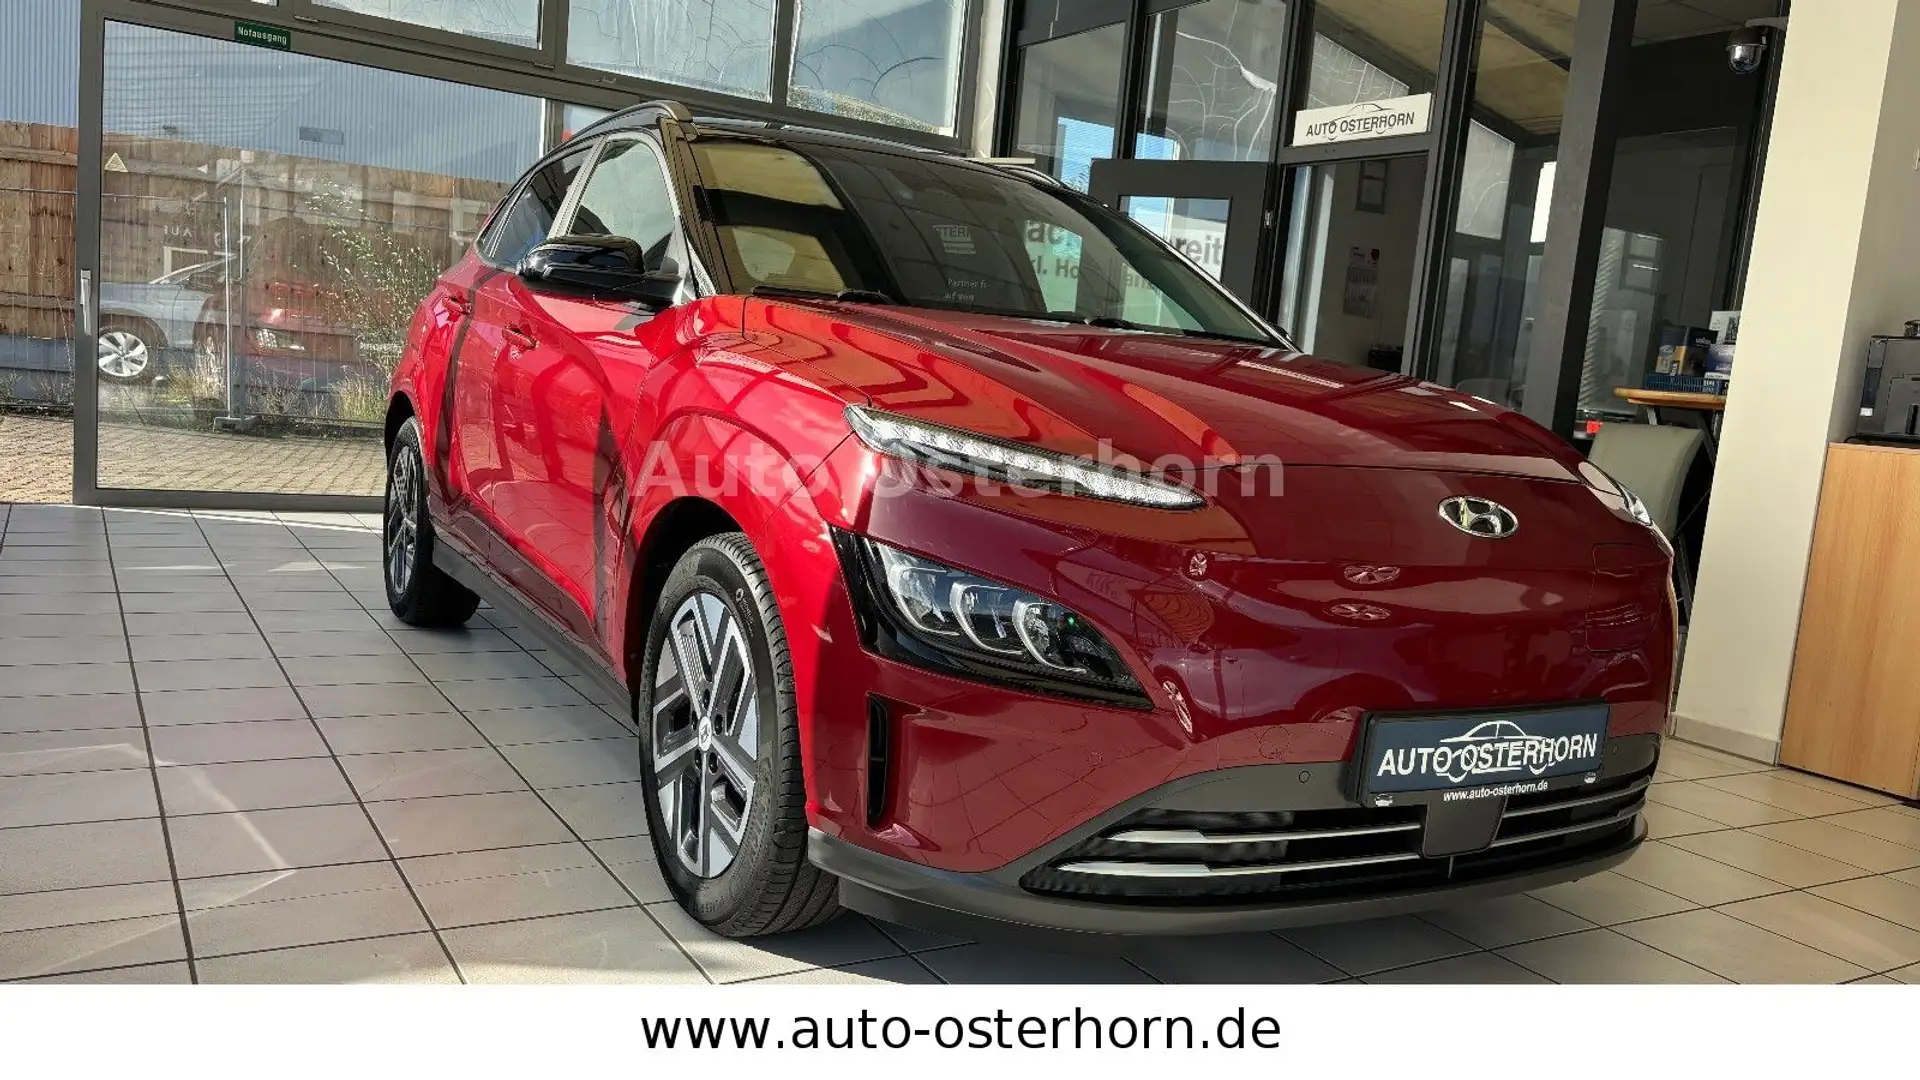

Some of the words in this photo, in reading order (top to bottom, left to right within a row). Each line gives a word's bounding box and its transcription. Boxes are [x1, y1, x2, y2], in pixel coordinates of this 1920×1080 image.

[237, 26, 288, 45] Notausgang
[1306, 121, 1337, 137] AUTO
[1340, 112, 1415, 133] OSTERHORN
[1169, 234, 1222, 265] reit
[1377, 746, 1451, 777] AUTO
[1460, 733, 1598, 770] OSTERHORN
[1443, 779, 1548, 802] www.auto-osterhorn.de
